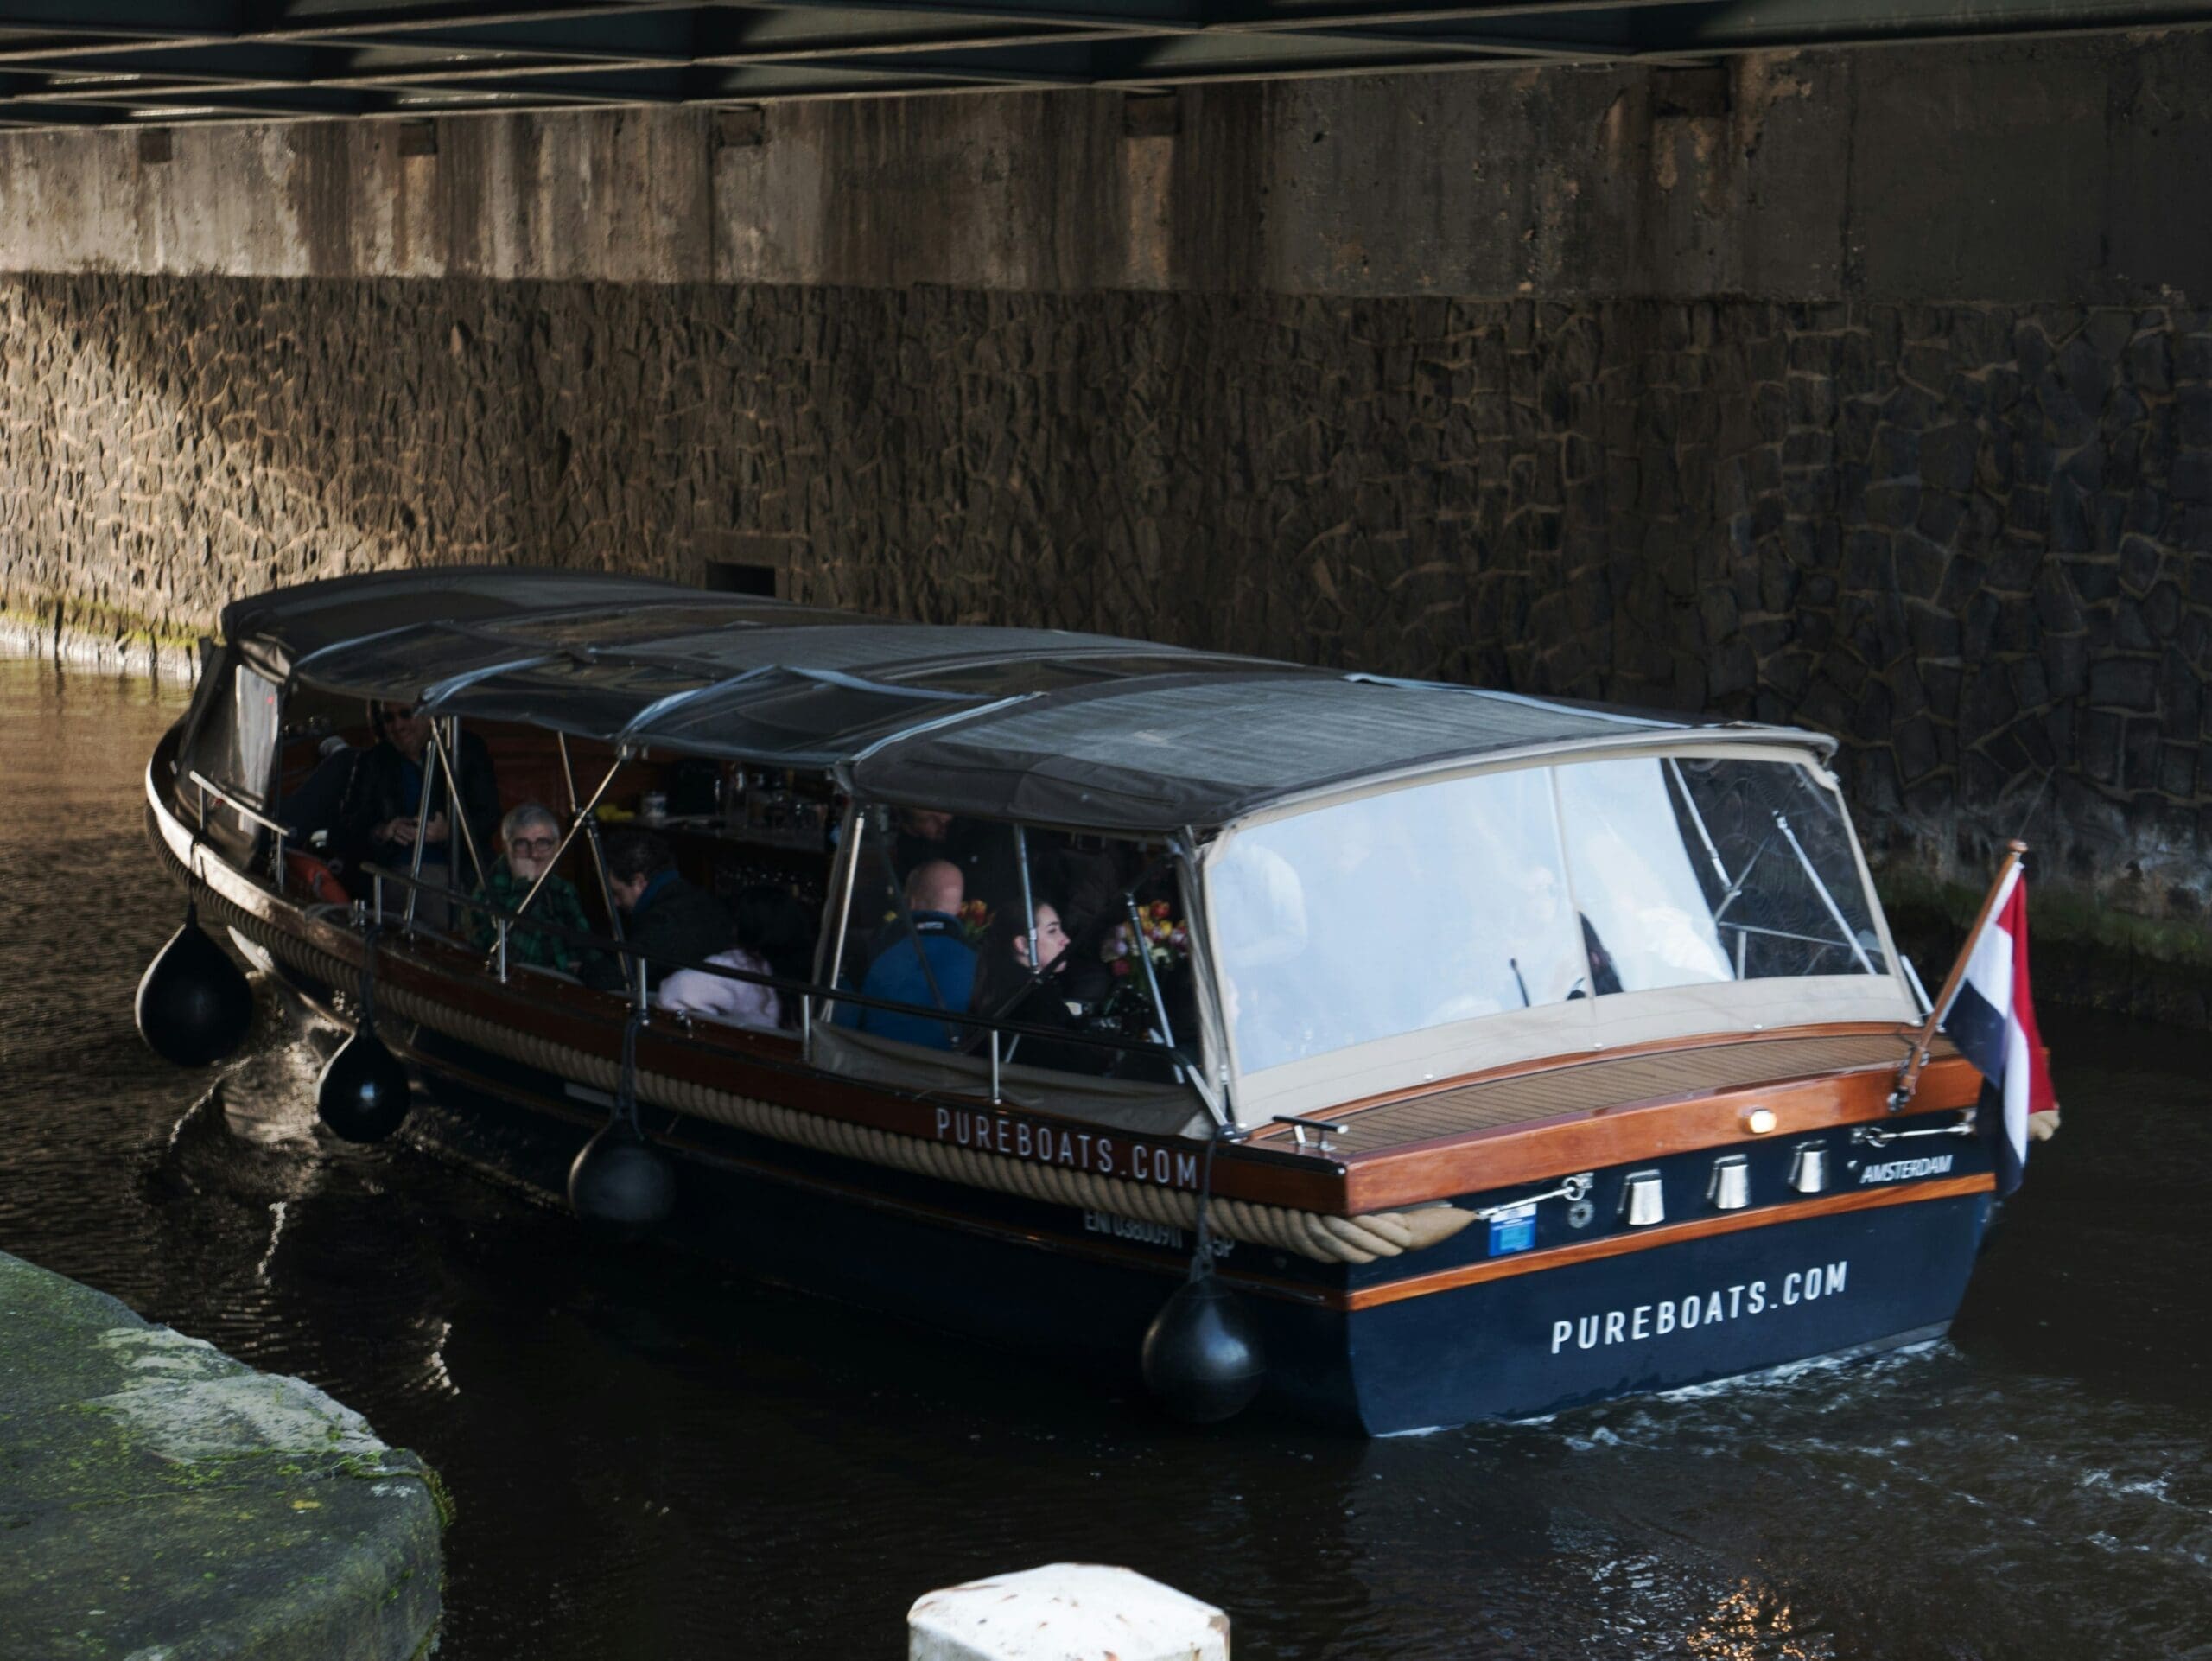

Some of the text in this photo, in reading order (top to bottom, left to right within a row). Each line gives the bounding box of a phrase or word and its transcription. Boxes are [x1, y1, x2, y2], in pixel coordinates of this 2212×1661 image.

[935, 1107, 1198, 1189] PUREBOATS.COM
[1859, 1154, 1954, 1184] AMSTERDAM
[1551, 1261, 1847, 1354] PUREBOATS.COM
